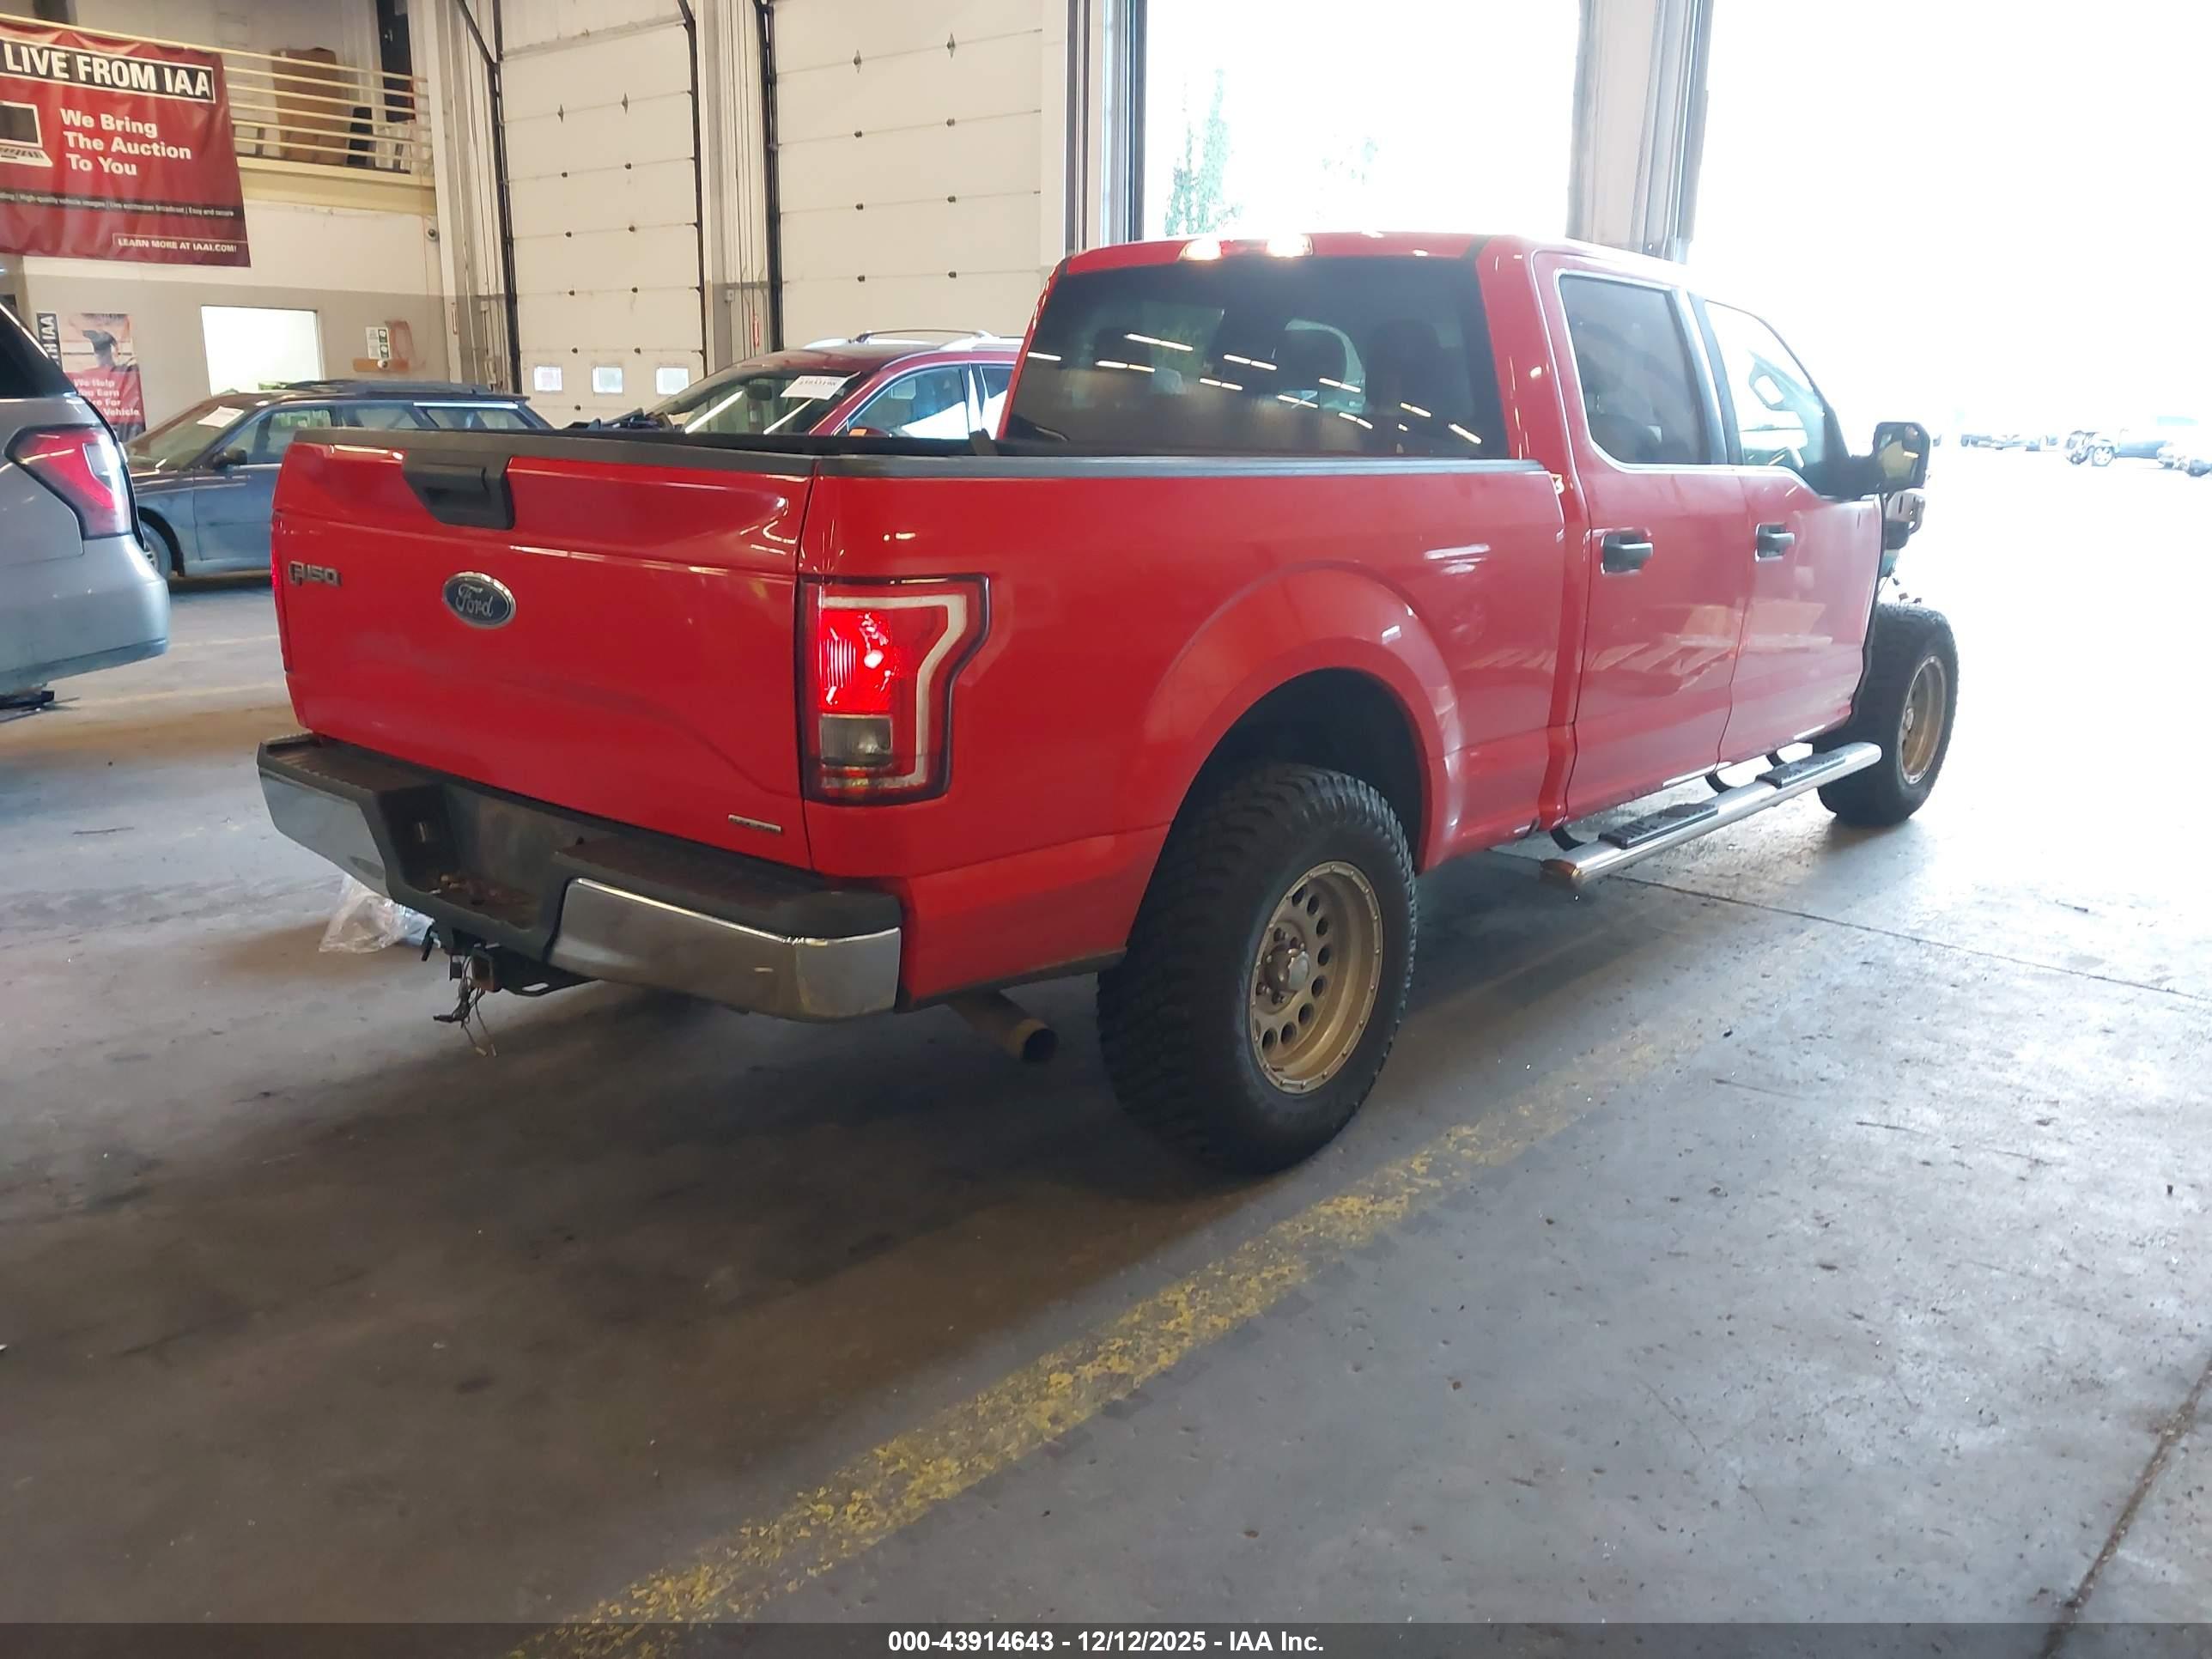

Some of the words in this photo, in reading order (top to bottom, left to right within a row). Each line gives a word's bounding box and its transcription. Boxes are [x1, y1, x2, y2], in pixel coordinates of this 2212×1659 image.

[3, 43, 70, 79] LIVE
[76, 54, 157, 91] FROM
[163, 67, 210, 97] IAA
[59, 107, 94, 128] We
[100, 113, 158, 139] Bring
[63, 131, 104, 150] The
[111, 136, 191, 160] Auction
[65, 153, 93, 171] To
[97, 156, 137, 176] You
[118, 238, 149, 247] LEARN
[151, 240, 178, 250] MORE
[179, 241, 191, 250] AT
[40, 315, 56, 340] IAA
[92, 379, 115, 388] Help
[96, 388, 119, 397] Earn
